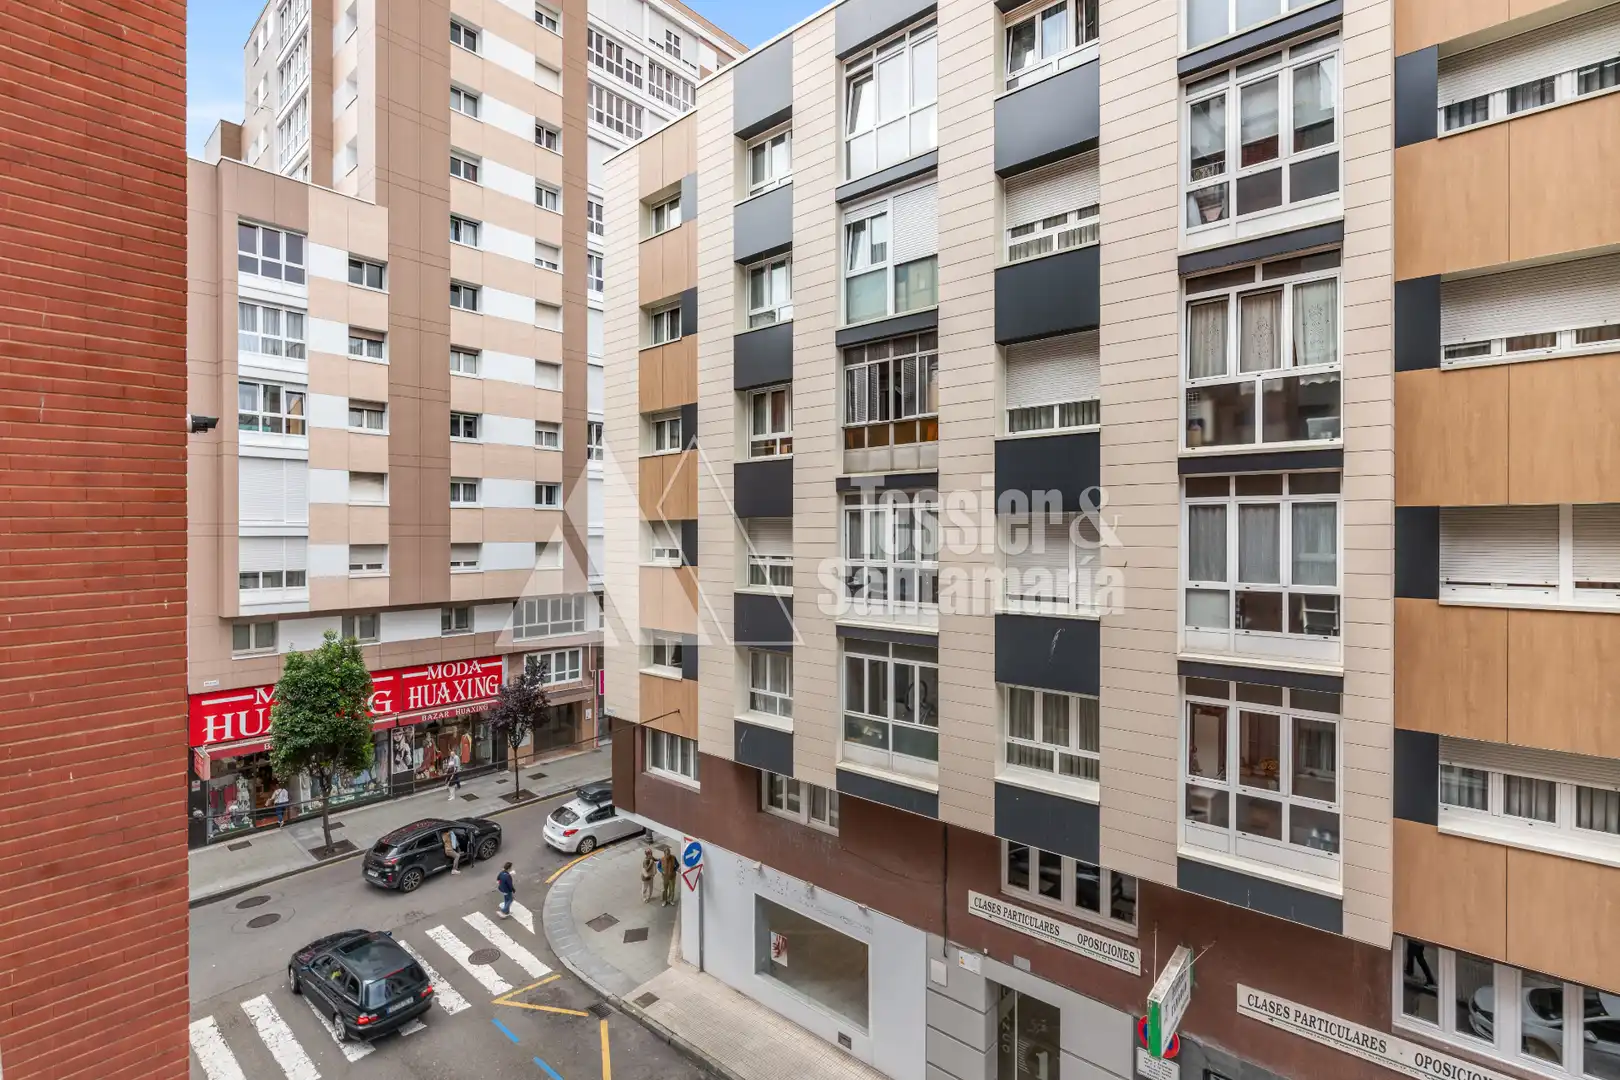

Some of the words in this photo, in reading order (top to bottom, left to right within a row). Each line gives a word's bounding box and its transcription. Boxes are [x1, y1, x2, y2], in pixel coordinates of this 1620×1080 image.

[427, 660, 482, 681] MODA
[408, 675, 500, 709] HUAXING
[421, 711, 450, 721] BAZAR
[455, 704, 489, 716] HUAXING
[974, 896, 1002, 916] CLASES
[1003, 906, 1060, 936] PARTICULARES
[1077, 933, 1135, 963] OPOSICIONES
[1247, 993, 1291, 1020] CLASES
[1294, 1009, 1387, 1054] PARTICULARES
